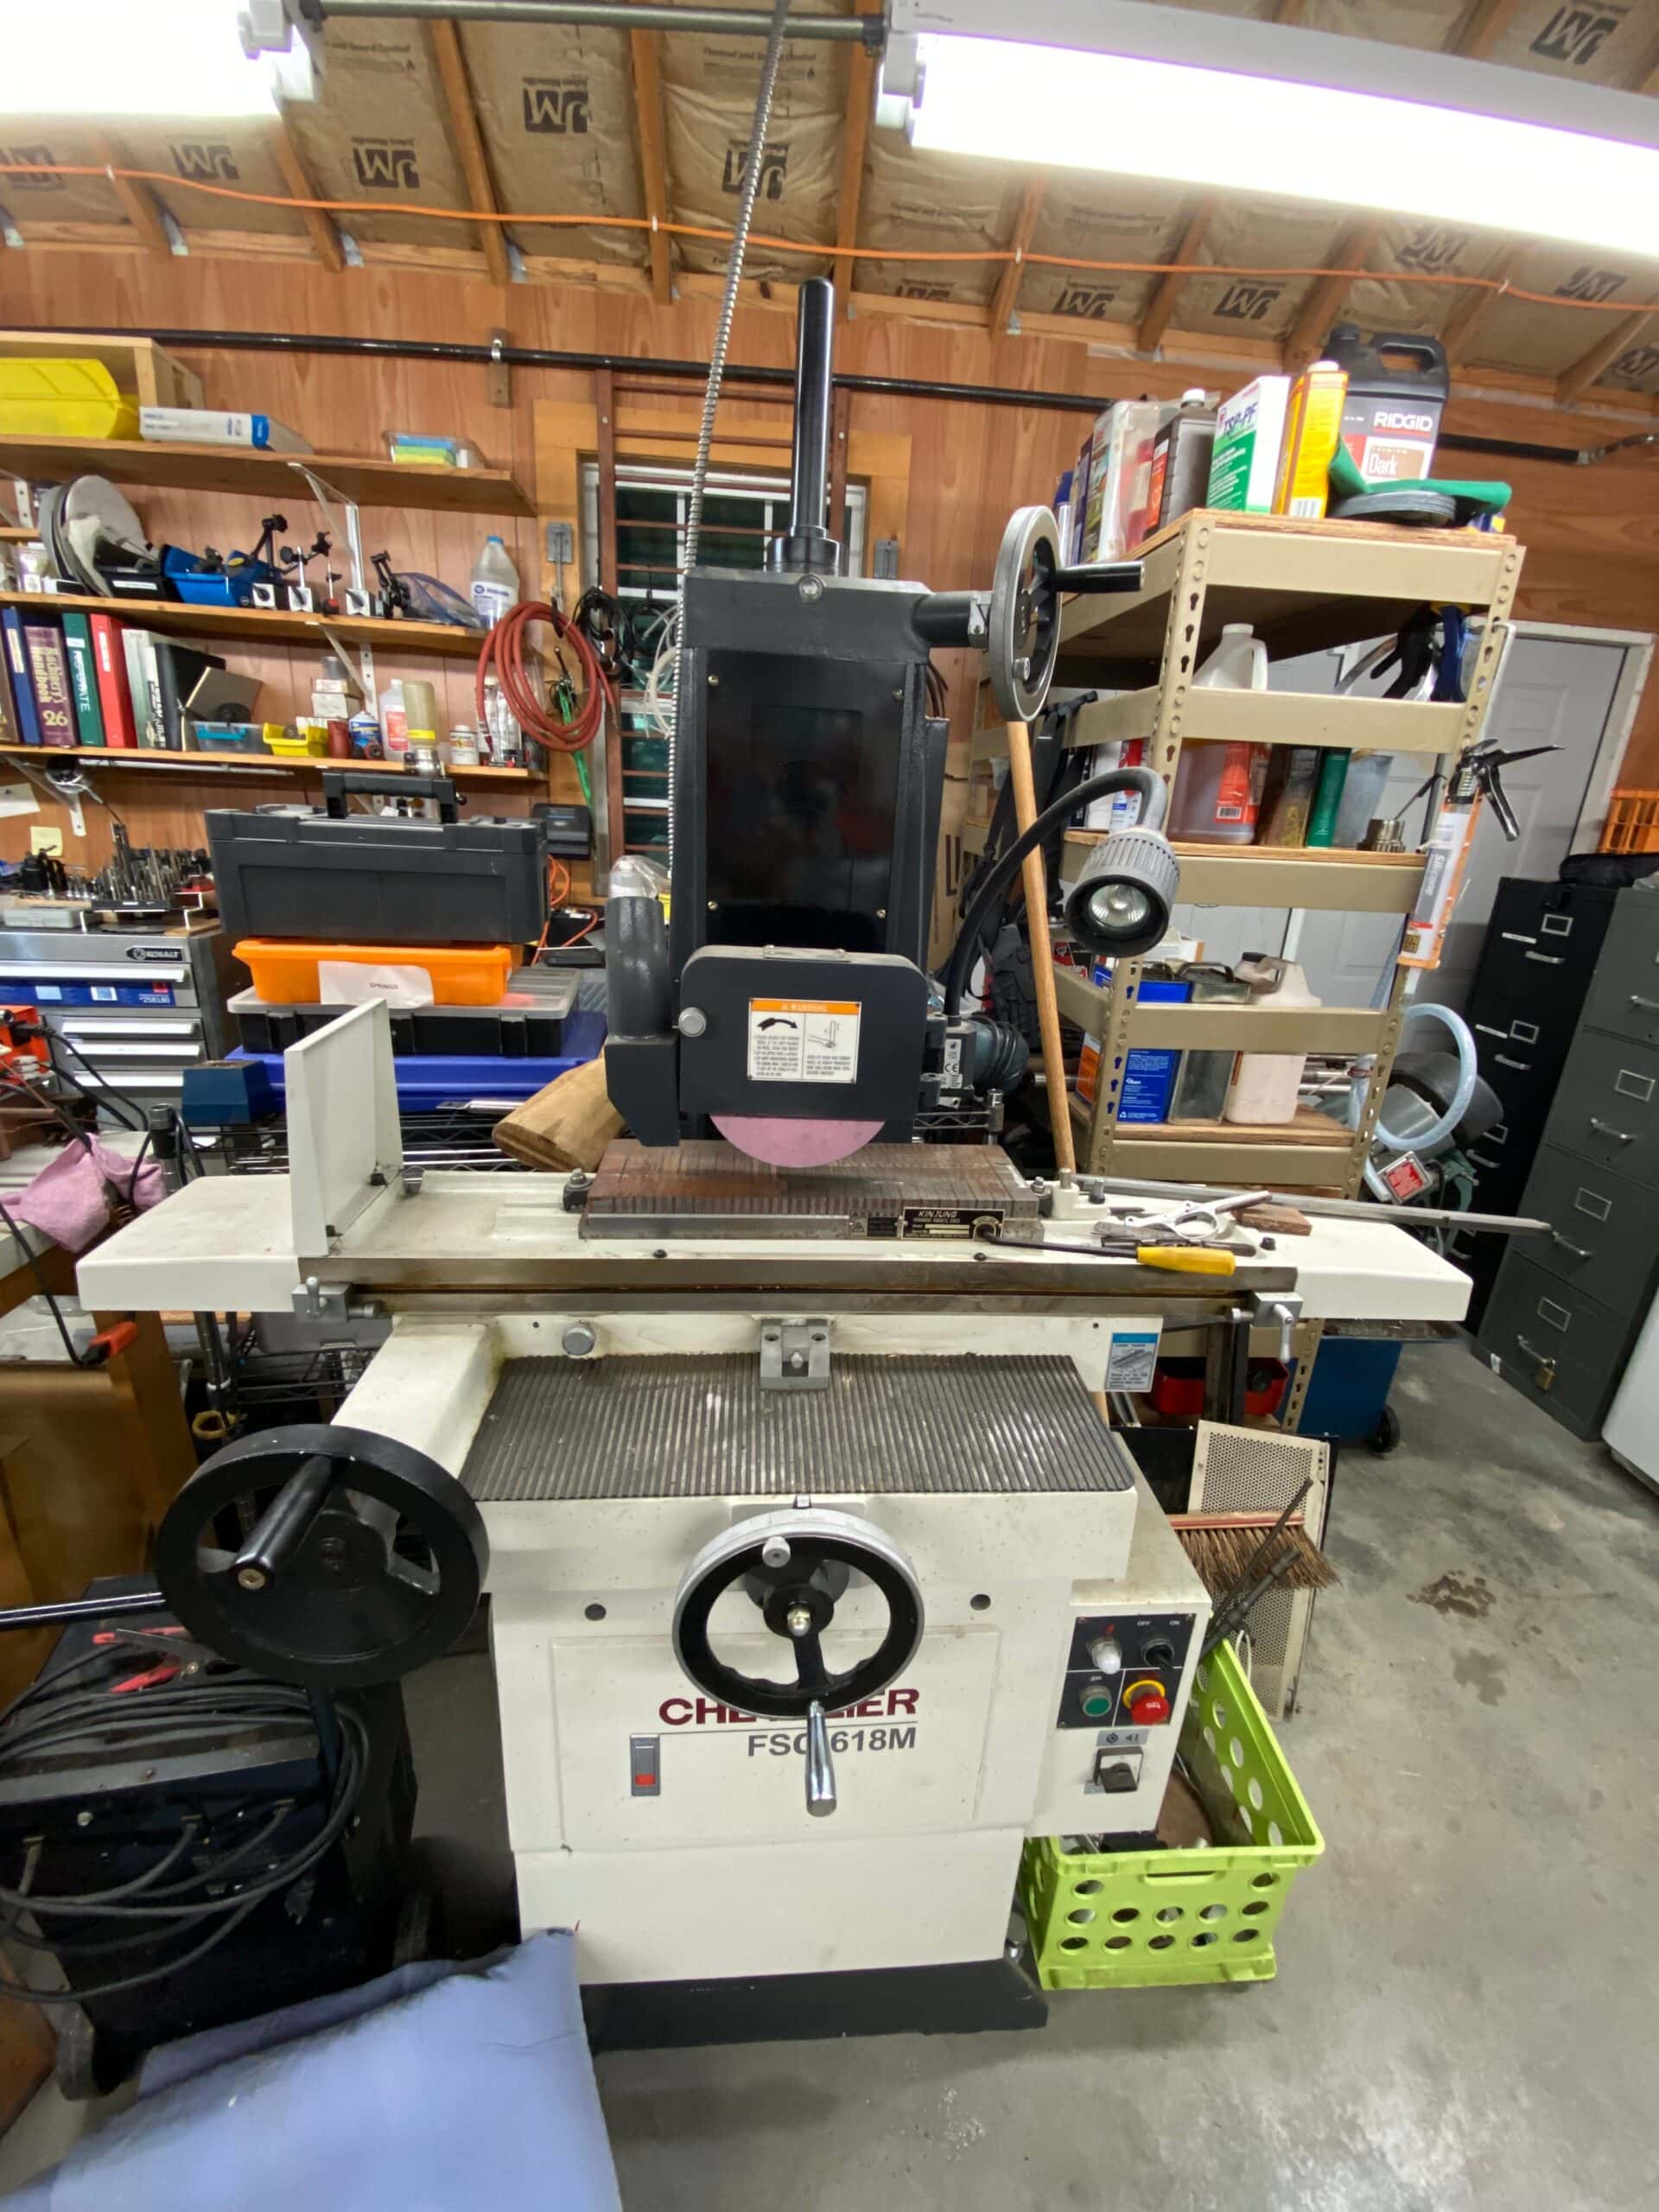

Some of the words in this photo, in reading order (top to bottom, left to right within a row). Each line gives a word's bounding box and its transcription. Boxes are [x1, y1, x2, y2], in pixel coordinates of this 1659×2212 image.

[1529, 6, 1619, 66] JM
[522, 86, 592, 134] JM
[168, 144, 240, 180] JM
[353, 147, 420, 189] JM
[1554, 265, 1628, 302] JM
[1052, 289, 1115, 319] JM
[1213, 285, 1281, 321] JM
[1372, 410, 1433, 432] RIDGID
[1369, 454, 1398, 477] Dark
[30, 646, 53, 702] Handbook
[42, 709, 69, 728] 26
[1424, 854, 1446, 897] Silicone
[918, 1210, 958, 1218] KINJUNG
